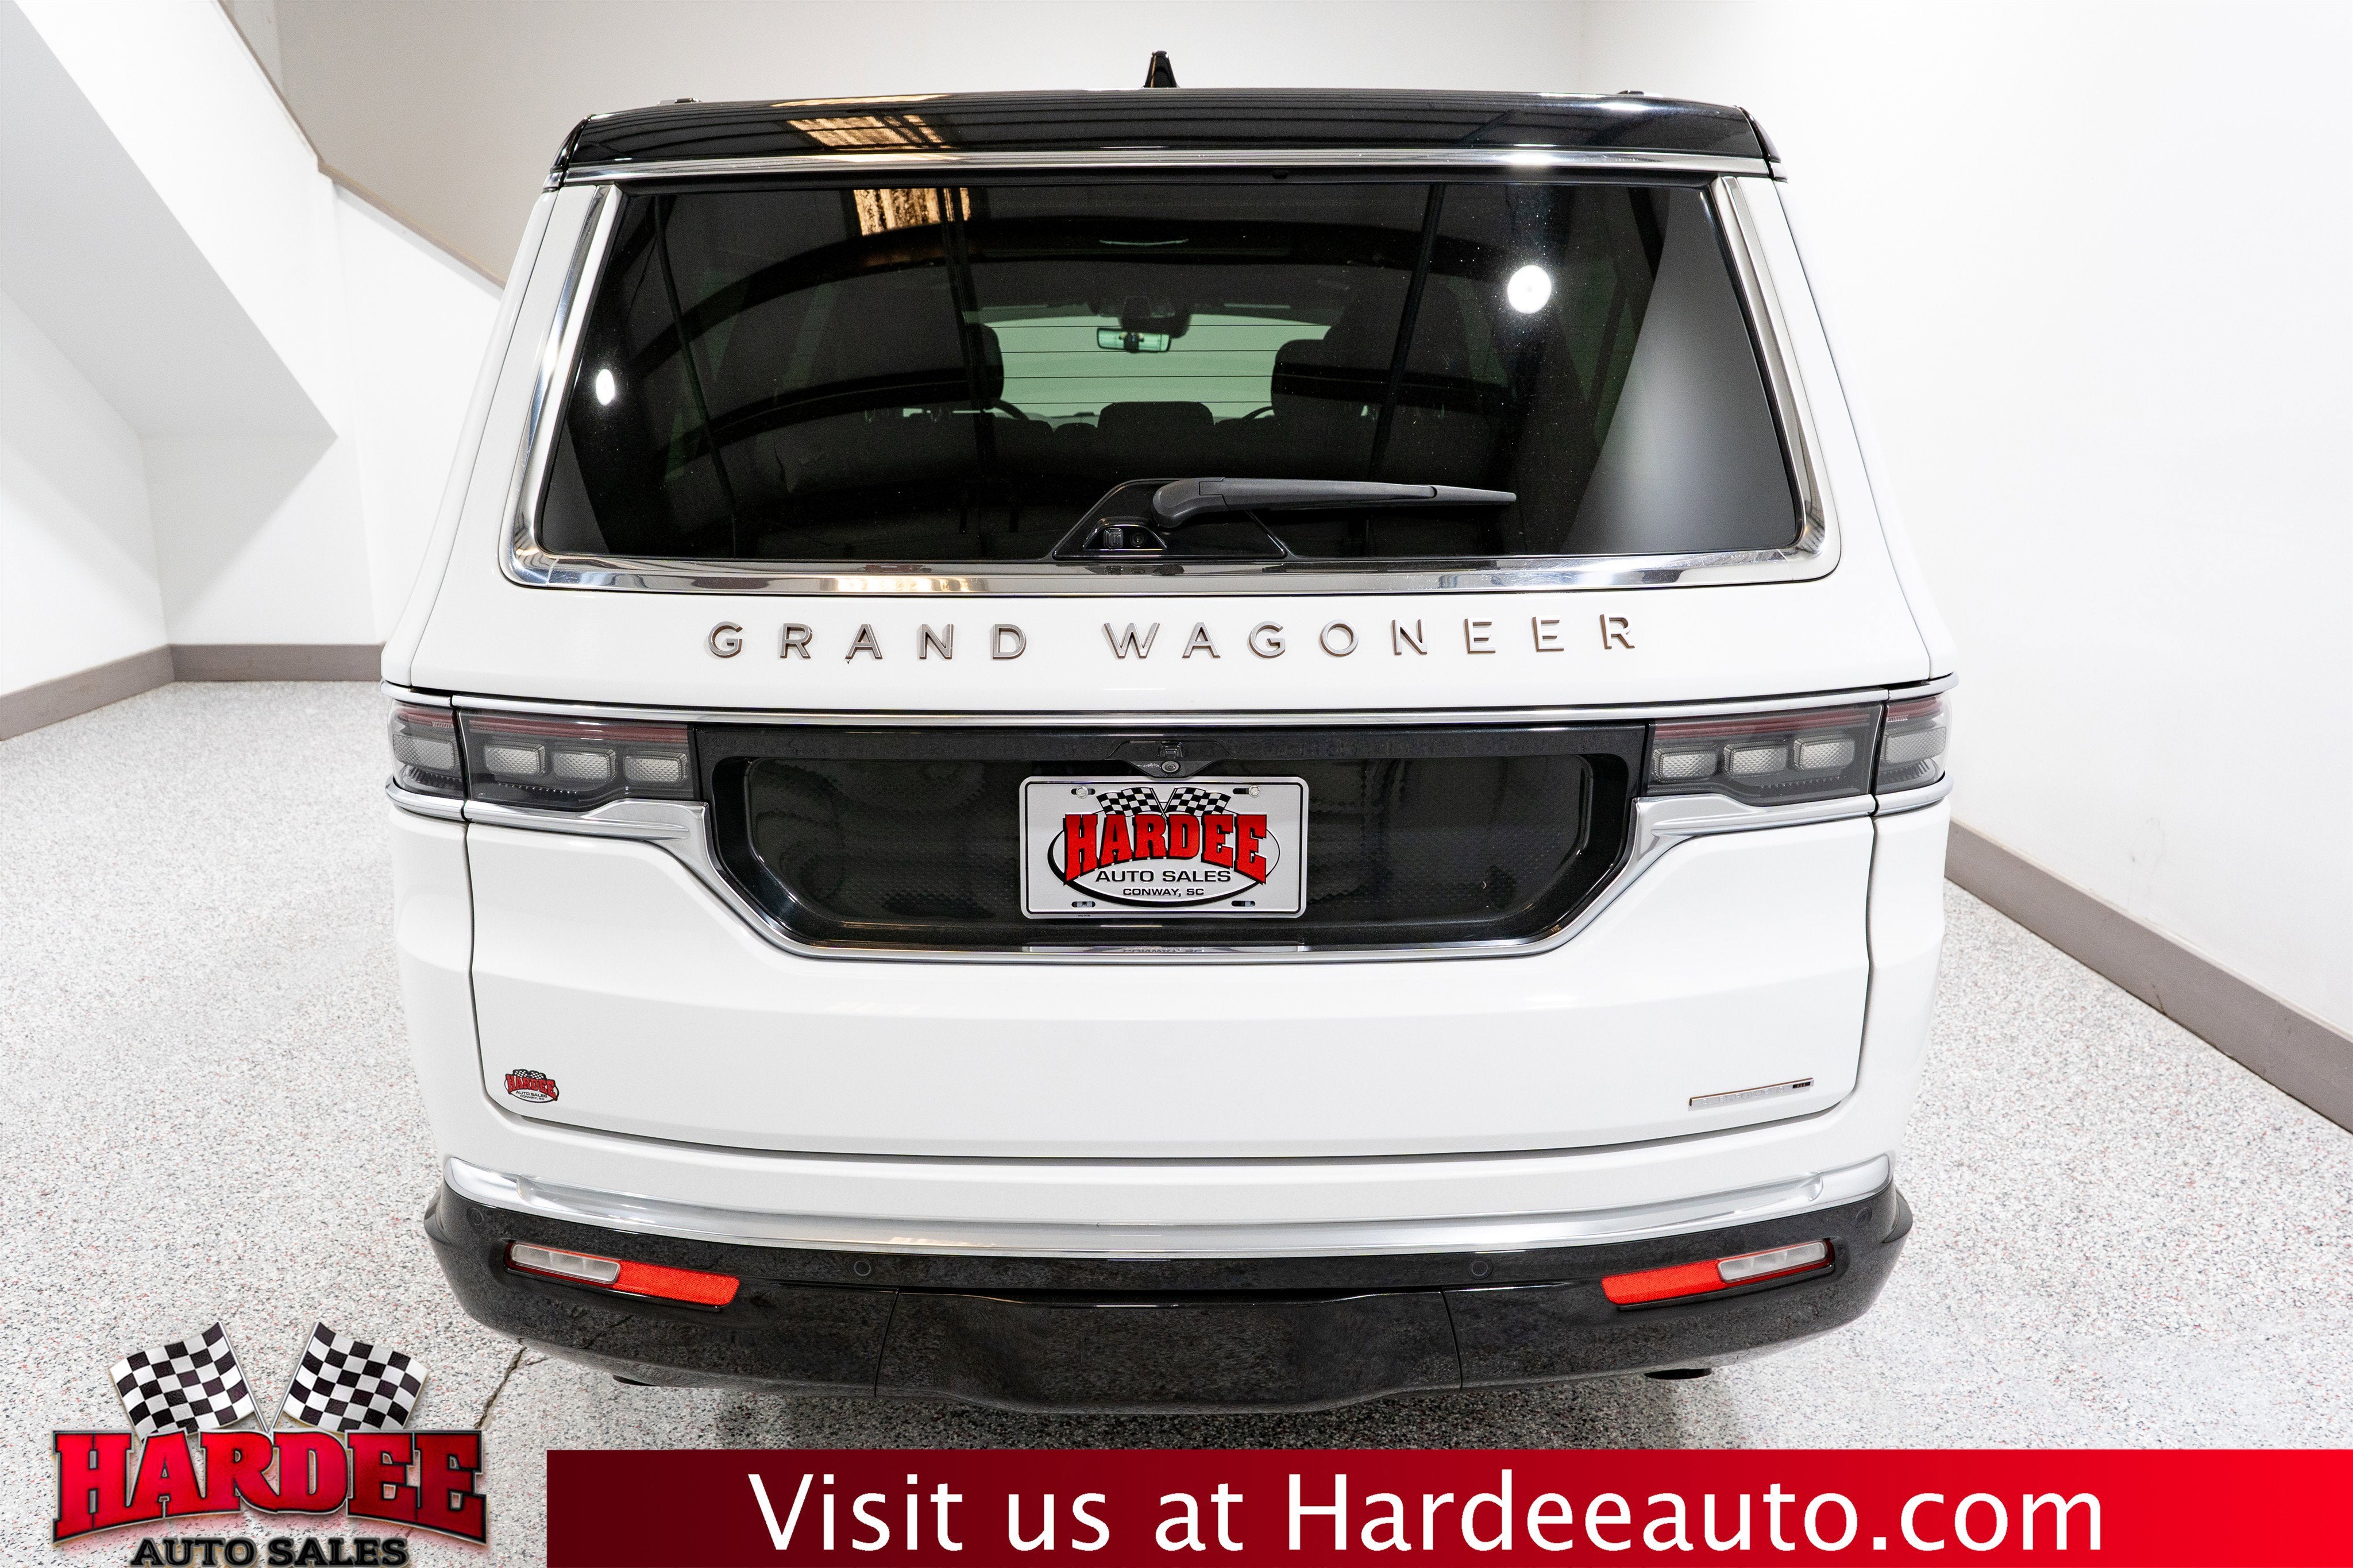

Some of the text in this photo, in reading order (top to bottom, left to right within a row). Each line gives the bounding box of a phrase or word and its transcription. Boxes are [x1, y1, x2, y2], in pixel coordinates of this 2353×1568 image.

[707, 613, 1636, 660] GRAND WAGONEER
[1063, 814, 1267, 885] HARDEE
[1095, 870, 1231, 882] AUTO SALES
[1123, 888, 1182, 897] CONWAY,
[506, 1074, 556, 1100] HARDEE
